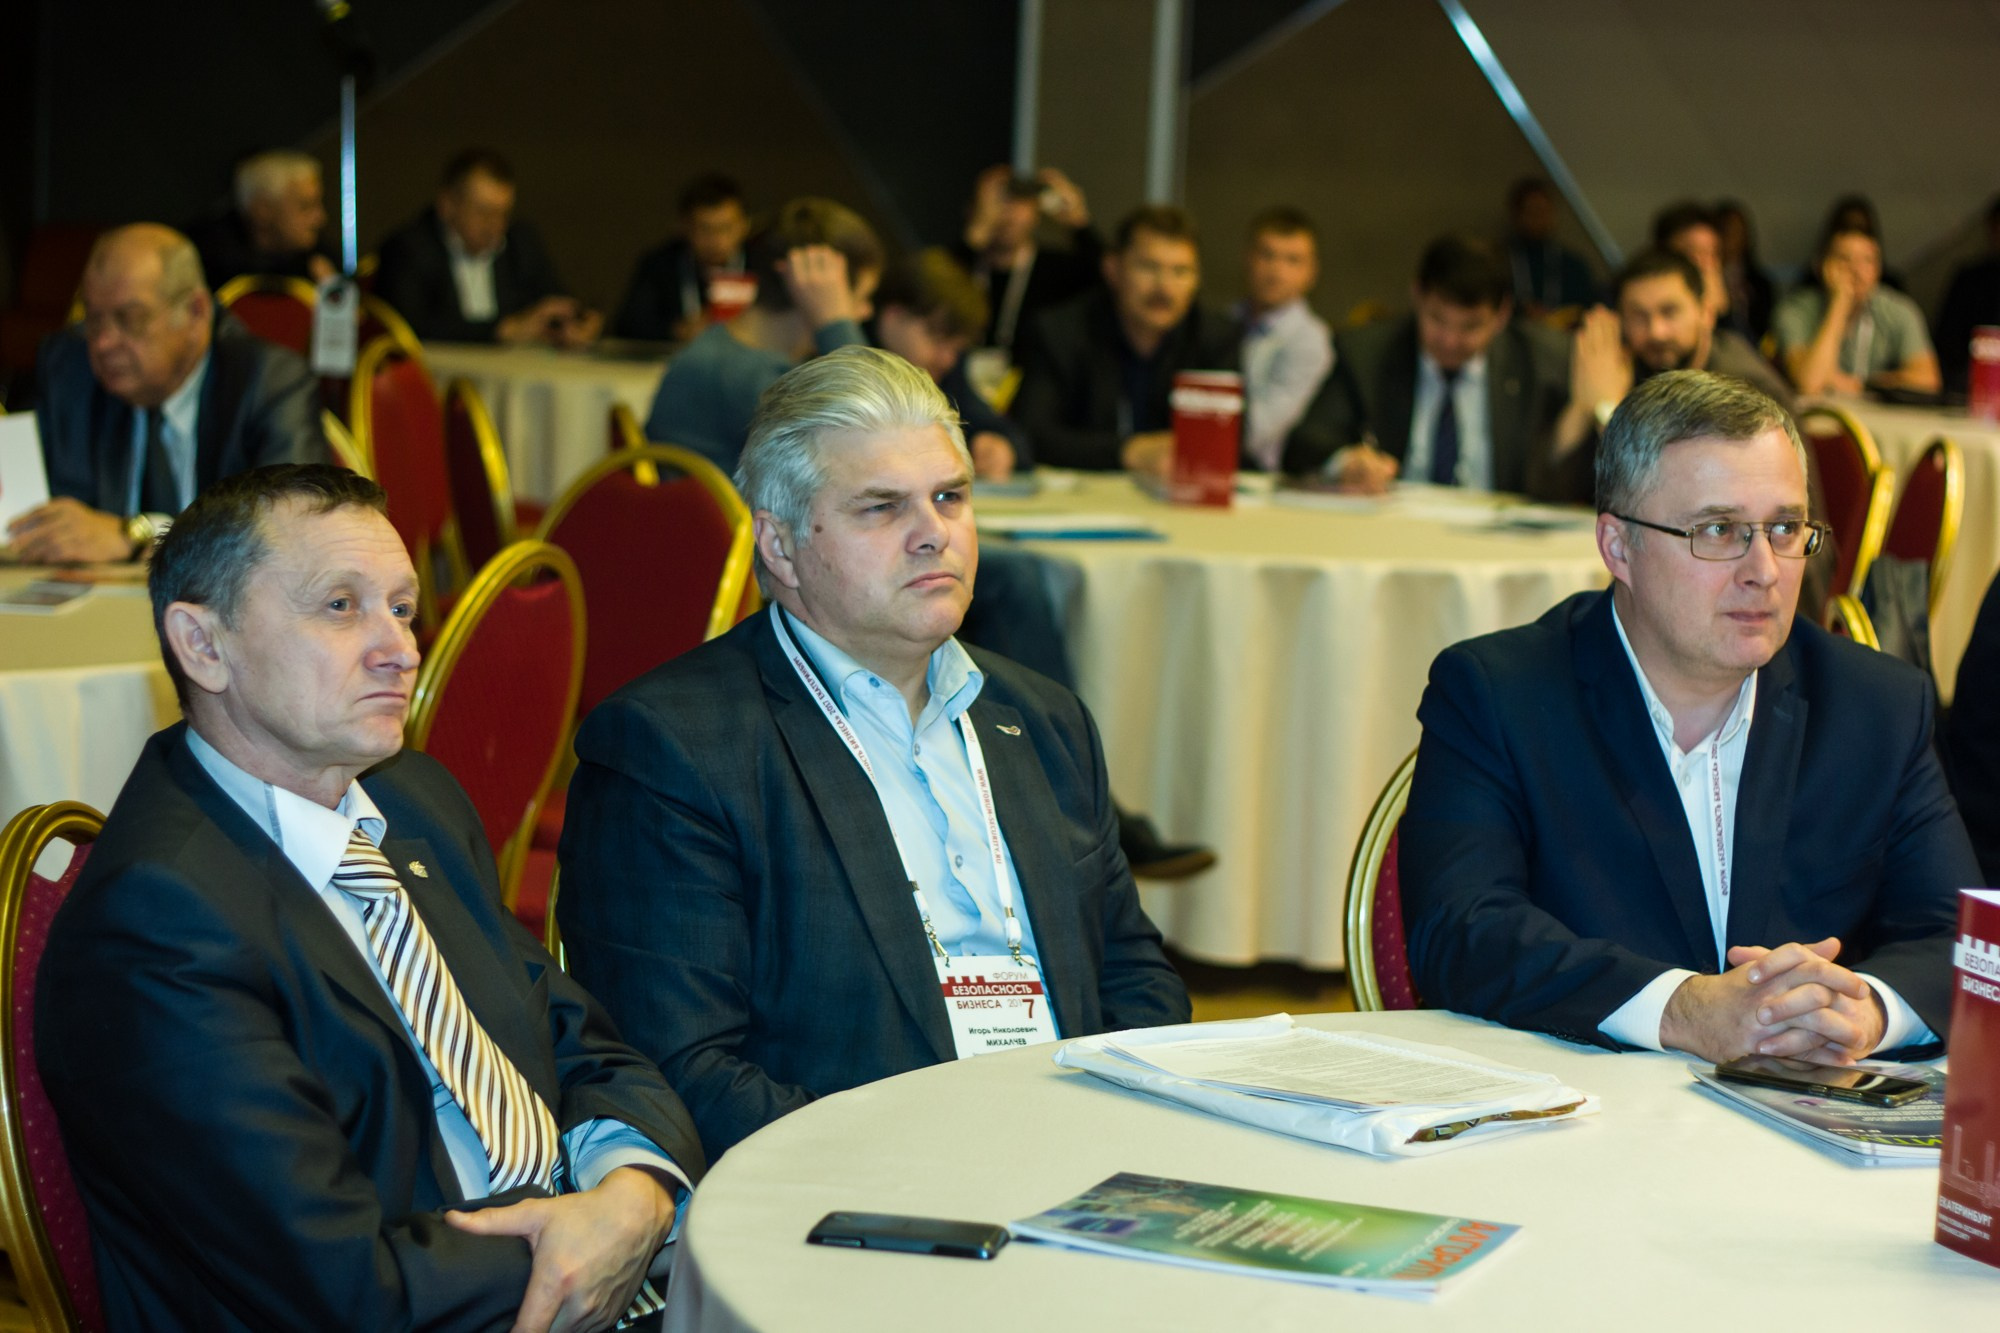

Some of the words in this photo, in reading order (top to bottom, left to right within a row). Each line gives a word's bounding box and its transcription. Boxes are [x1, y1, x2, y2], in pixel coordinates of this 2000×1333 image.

[823, 700, 836, 715] 2017
[992, 971, 1029, 981] ФОРУМ
[952, 984, 1033, 995] БЕЗОПАСНОСТЬ
[956, 999, 1003, 1010] БИЗНЕСА
[968, 1027, 992, 1035] Игорь
[992, 1027, 1038, 1035] Николаевич
[986, 1038, 1027, 1047] МИХАЛЧЕВ
